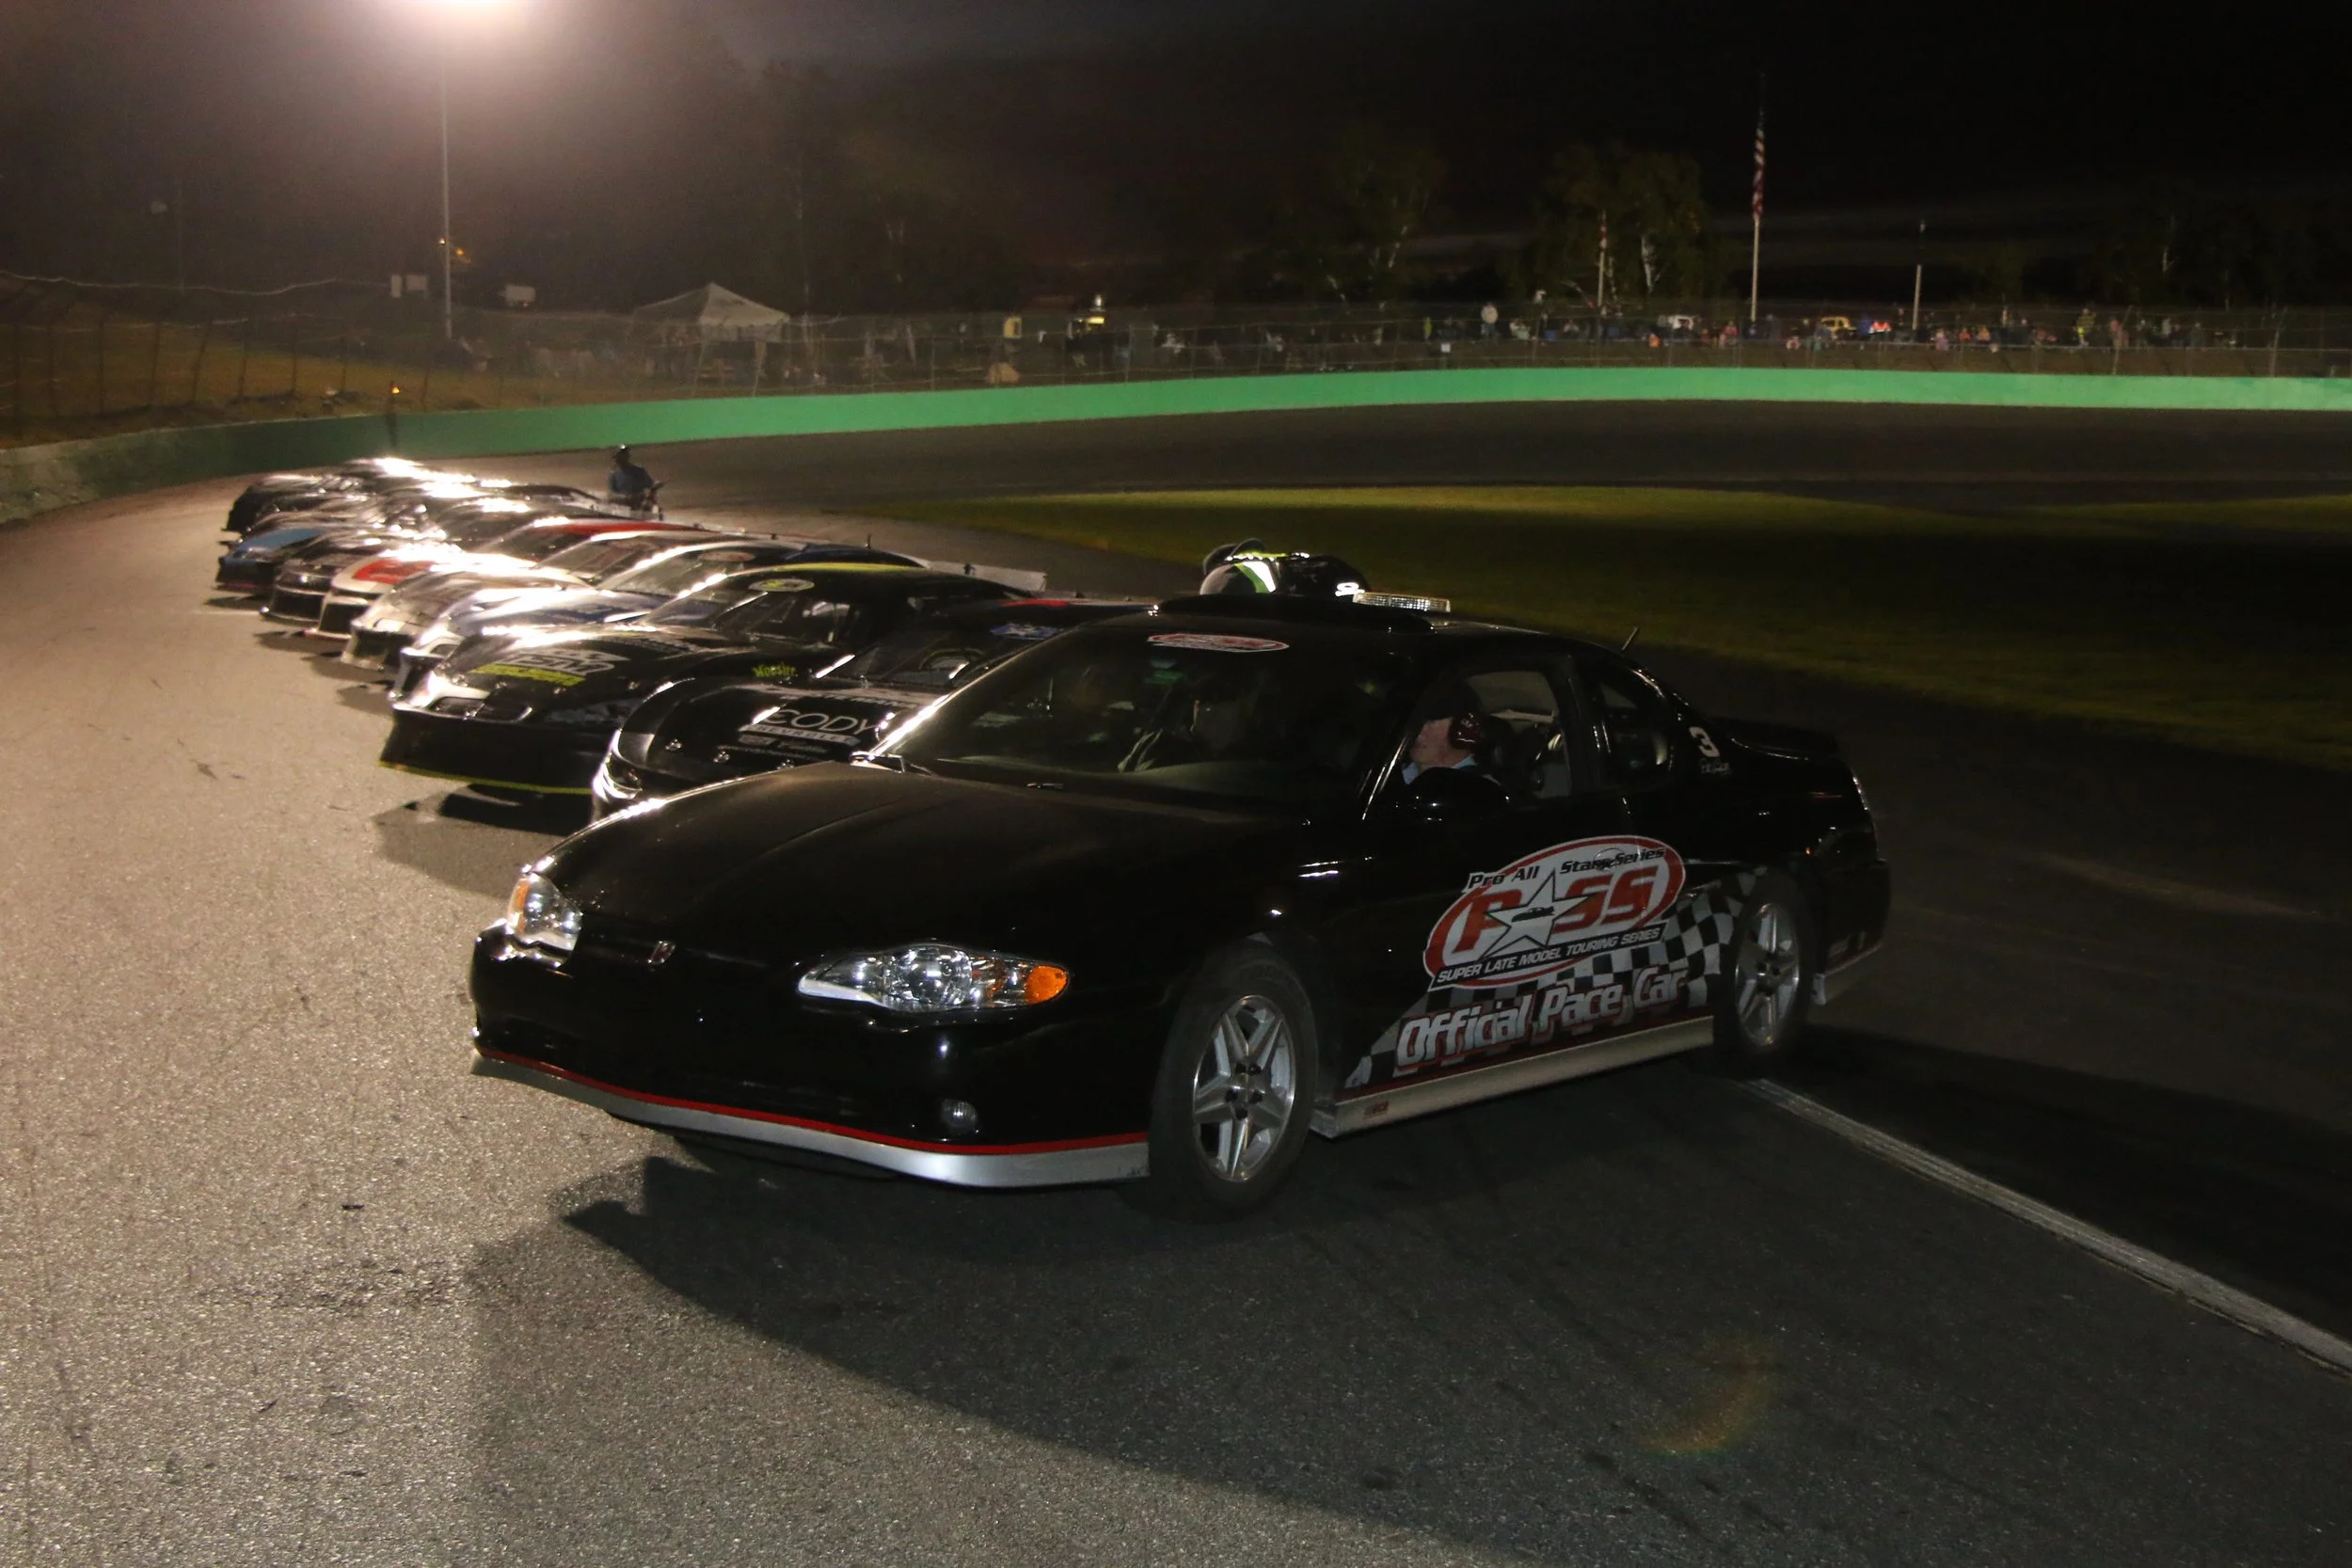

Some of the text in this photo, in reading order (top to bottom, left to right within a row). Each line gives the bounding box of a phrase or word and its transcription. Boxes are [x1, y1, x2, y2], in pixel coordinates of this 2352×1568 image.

[763, 709, 877, 735] CODY
[1689, 726, 1720, 757] 3
[1469, 873, 1505, 889] Pro
[1511, 865, 1541, 882] All
[1614, 847, 1665, 867] Series
[1437, 927, 1661, 983] SUPER LATE MODEL TOURING SERIES
[1396, 967, 1688, 1067] Official Pace Car
